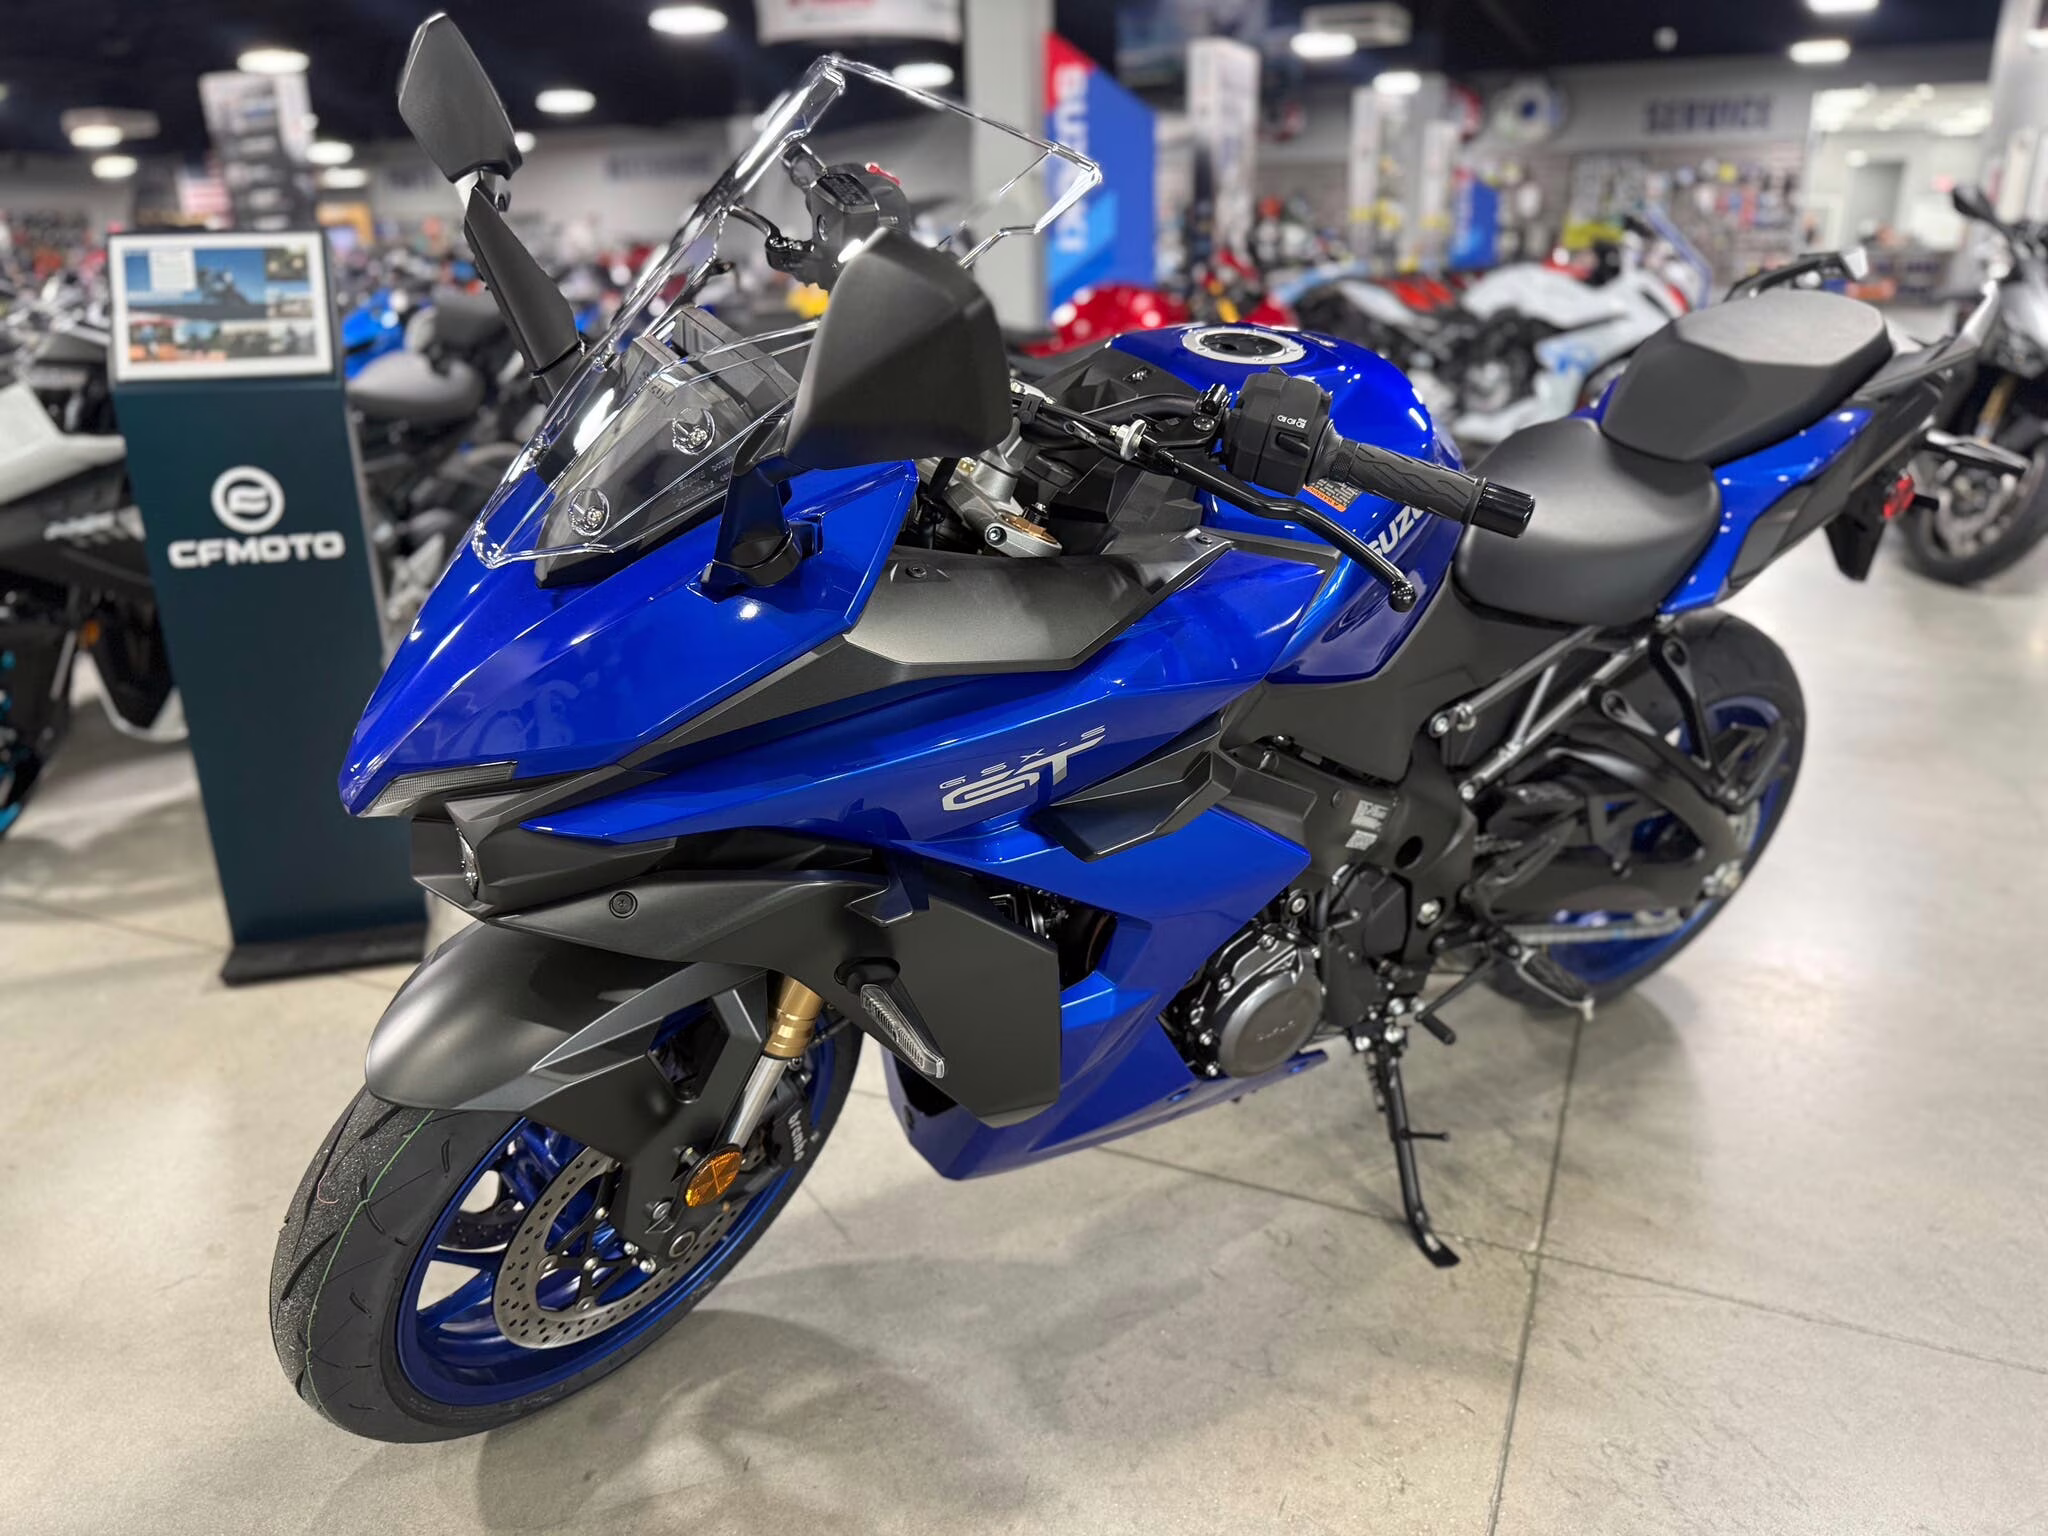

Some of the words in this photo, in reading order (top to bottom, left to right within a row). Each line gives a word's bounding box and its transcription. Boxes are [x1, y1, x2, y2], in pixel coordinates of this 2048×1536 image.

[167, 530, 346, 569] CFMOTO
[939, 725, 1106, 789] GSX-S
[942, 735, 1106, 811] GT
[788, 1109, 807, 1161] brembo
